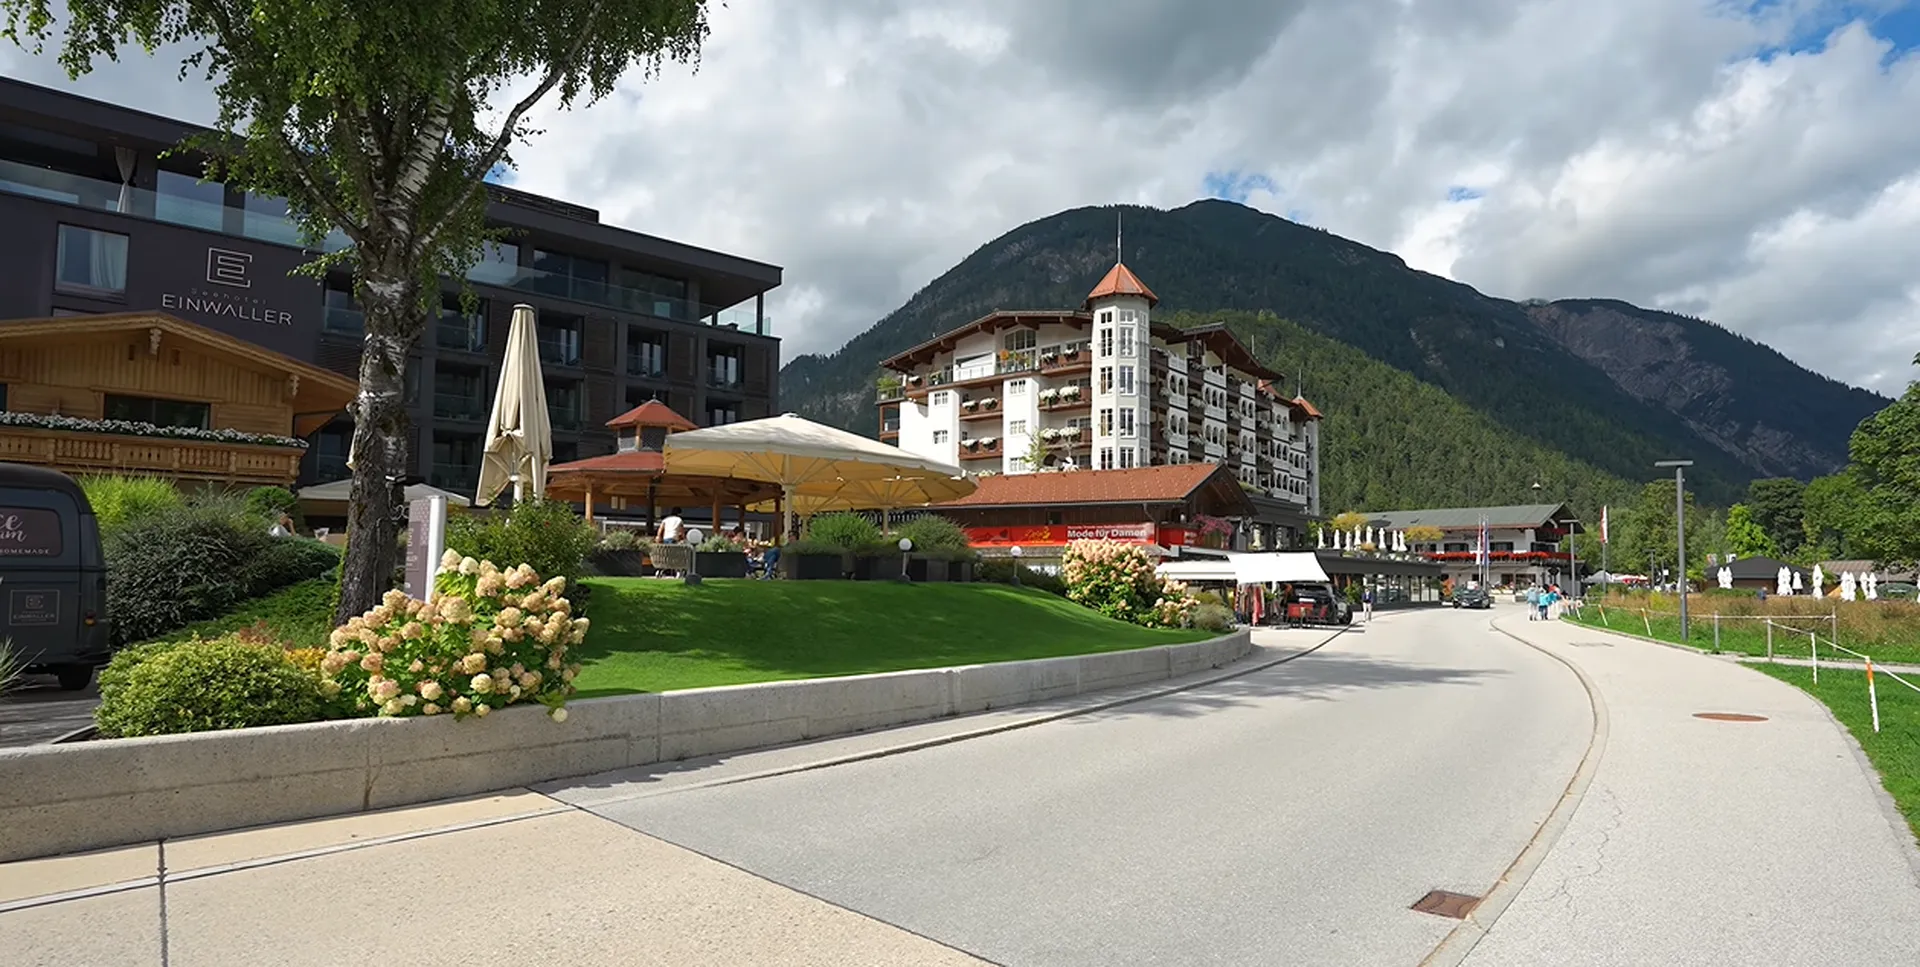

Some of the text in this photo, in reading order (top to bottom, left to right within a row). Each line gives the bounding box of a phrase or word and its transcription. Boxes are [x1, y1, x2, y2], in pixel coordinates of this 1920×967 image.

[190, 288, 267, 304] Seehotel
[162, 293, 293, 326] EINWALLER
[1067, 528, 1147, 538] Mode für Damen
